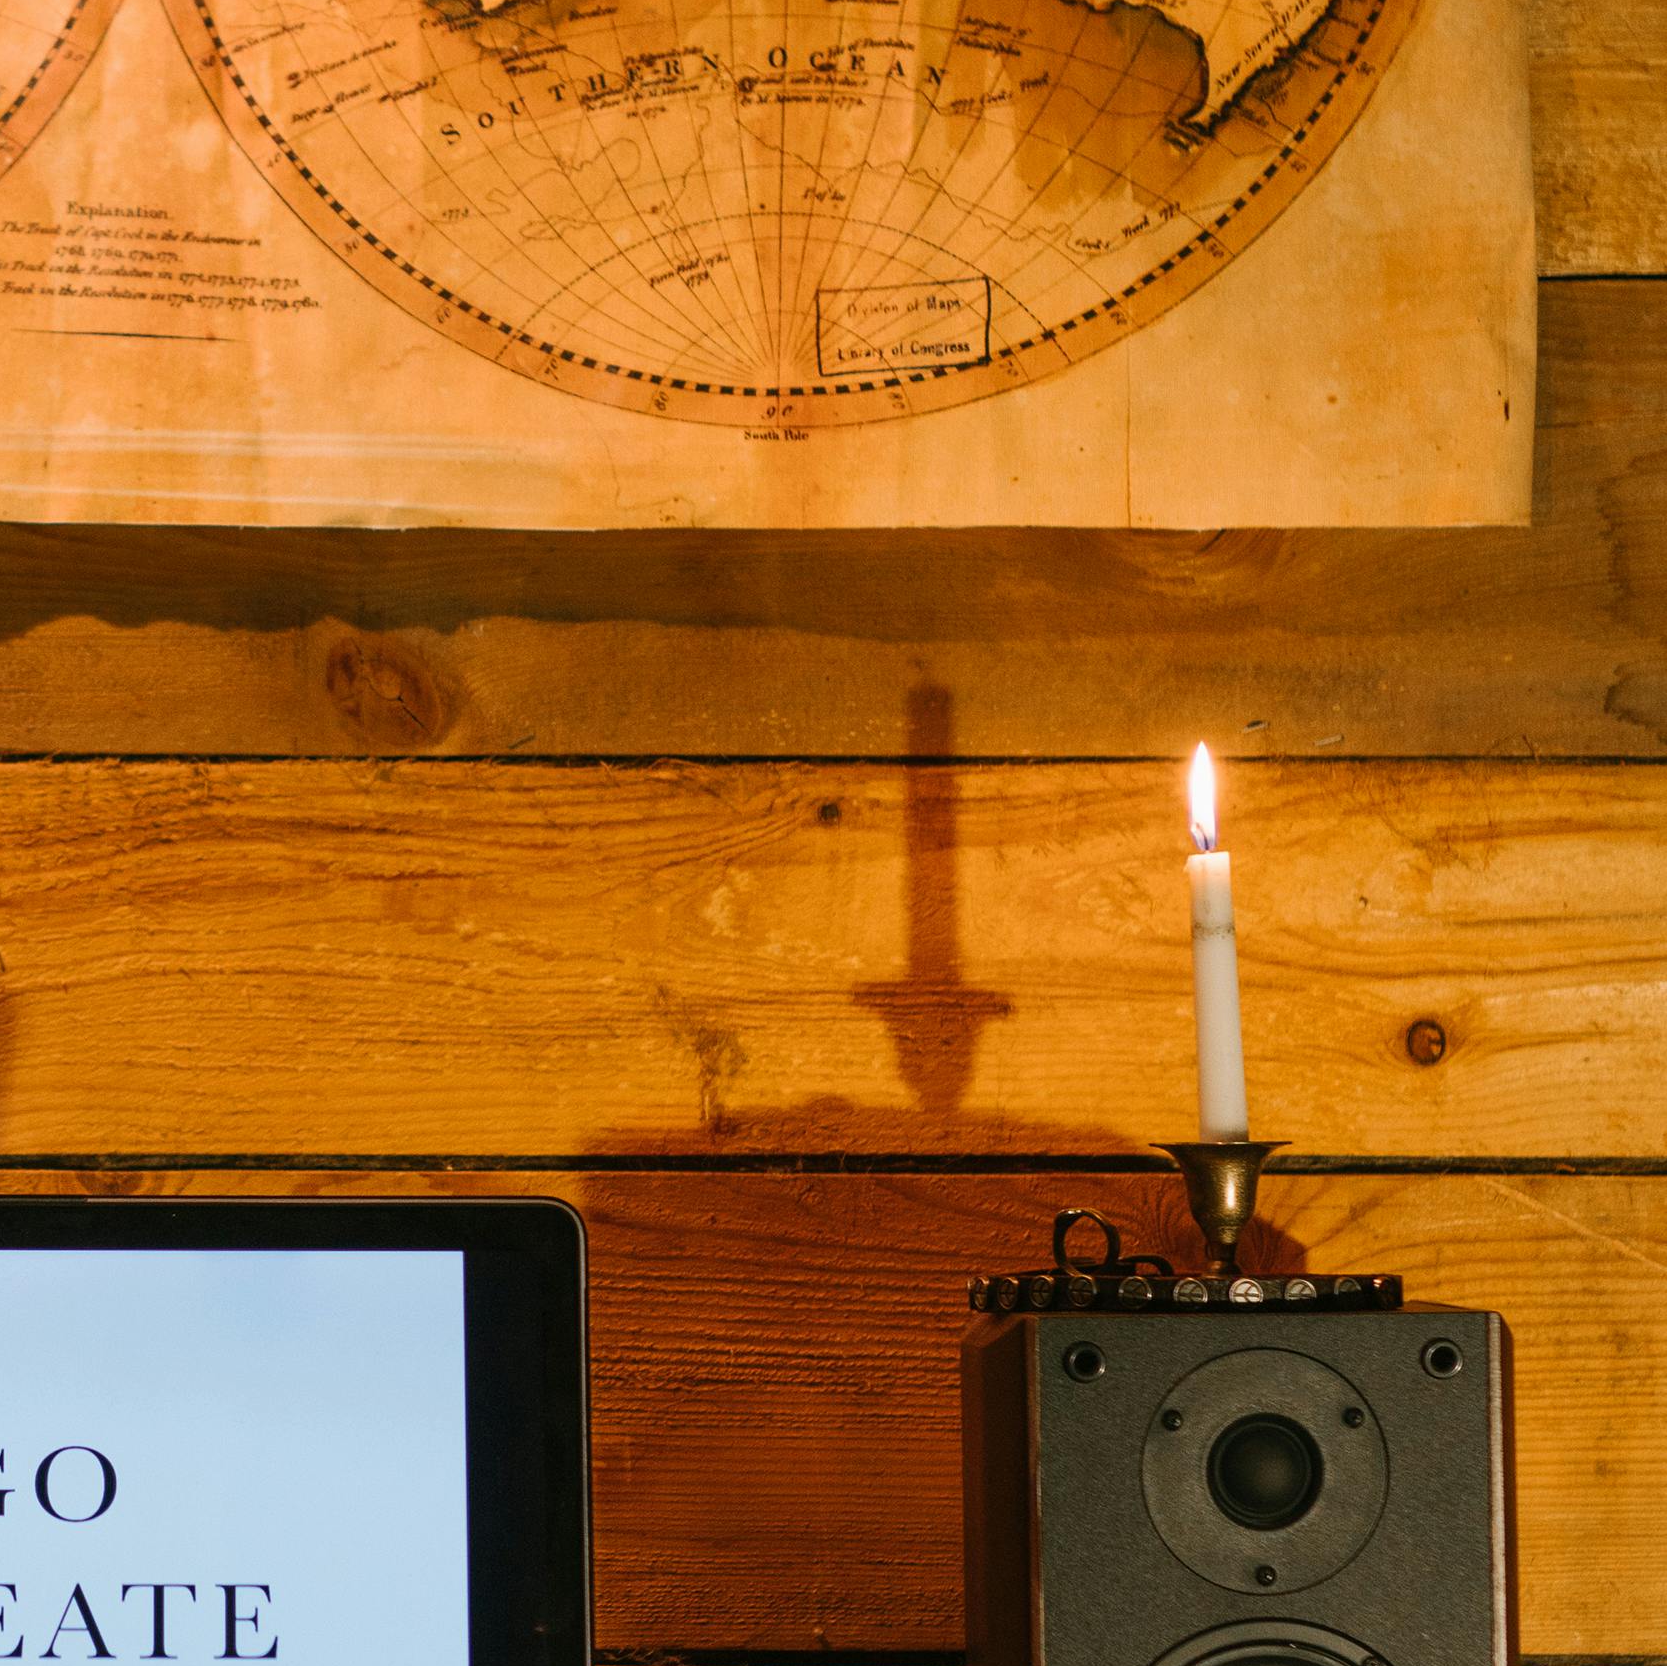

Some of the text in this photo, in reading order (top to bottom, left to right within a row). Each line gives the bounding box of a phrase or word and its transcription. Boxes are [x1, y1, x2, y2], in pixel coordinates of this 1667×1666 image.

[440, 52, 723, 147] SOUTHERN
[767, 45, 949, 87] OCEAN
[906, 298, 919, 313] of
[925, 295, 962, 314] Maps
[891, 339, 904, 356] of
[910, 340, 971, 358] Congress
[743, 429, 782, 442] South
